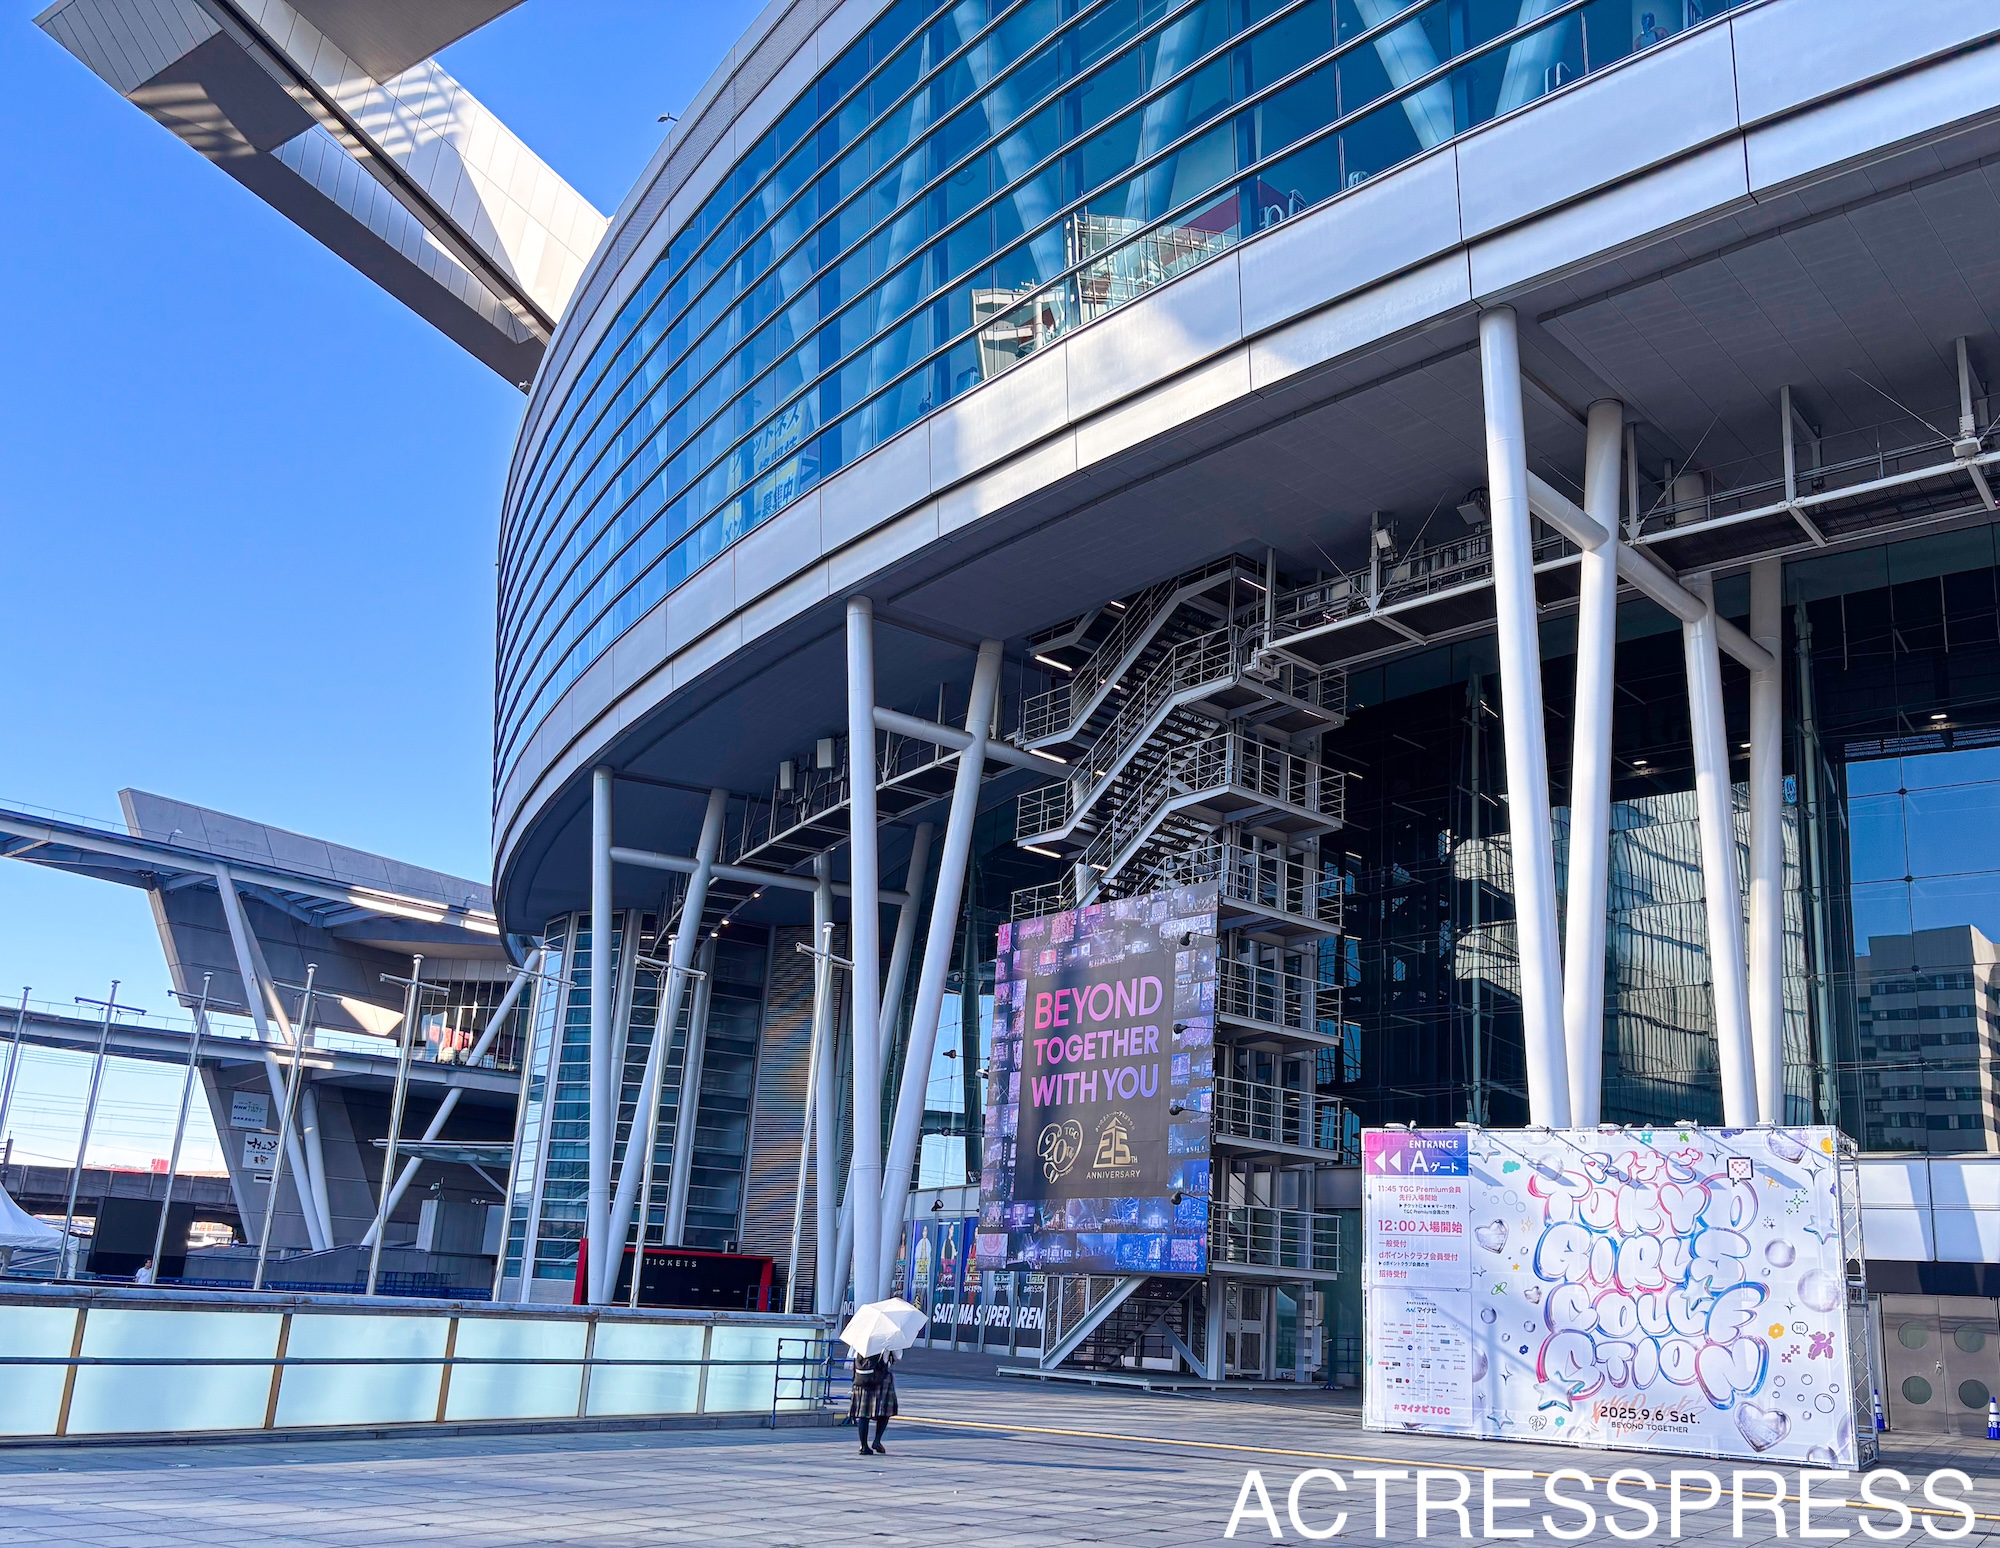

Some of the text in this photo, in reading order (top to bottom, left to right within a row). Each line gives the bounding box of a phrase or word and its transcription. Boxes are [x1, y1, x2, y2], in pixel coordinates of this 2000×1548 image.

[1034, 975, 1163, 1030] BEYOND
[1033, 1024, 1160, 1066] TOGETHER
[1031, 1063, 1159, 1108] WITH YOU
[1064, 1127, 1079, 1140] TGC
[1409, 1140, 1459, 1149] ENTRANCE
[1580, 1147, 1704, 1184] マイナビ
[1086, 1170, 1141, 1180] ANNIVERSARY
[1378, 1185, 1397, 1193] 11:45
[1399, 1185, 1414, 1193] TGC
[1527, 1169, 1759, 1237] TOKYO
[1378, 1220, 1463, 1234] 12:00 入場開始
[1379, 1239, 1407, 1248] 一般受付
[645, 1258, 697, 1268] TICKETS
[1532, 1221, 1752, 1293] GIRLS
[1417, 1306, 1437, 1314] マイナビ
[1543, 1280, 1770, 1344] COLLE
[1535, 1328, 1770, 1411] CTION
[1600, 1406, 1701, 1425] 2025.9.6 Sat.
[1611, 1421, 1689, 1433] BEYOND TOGETHER
